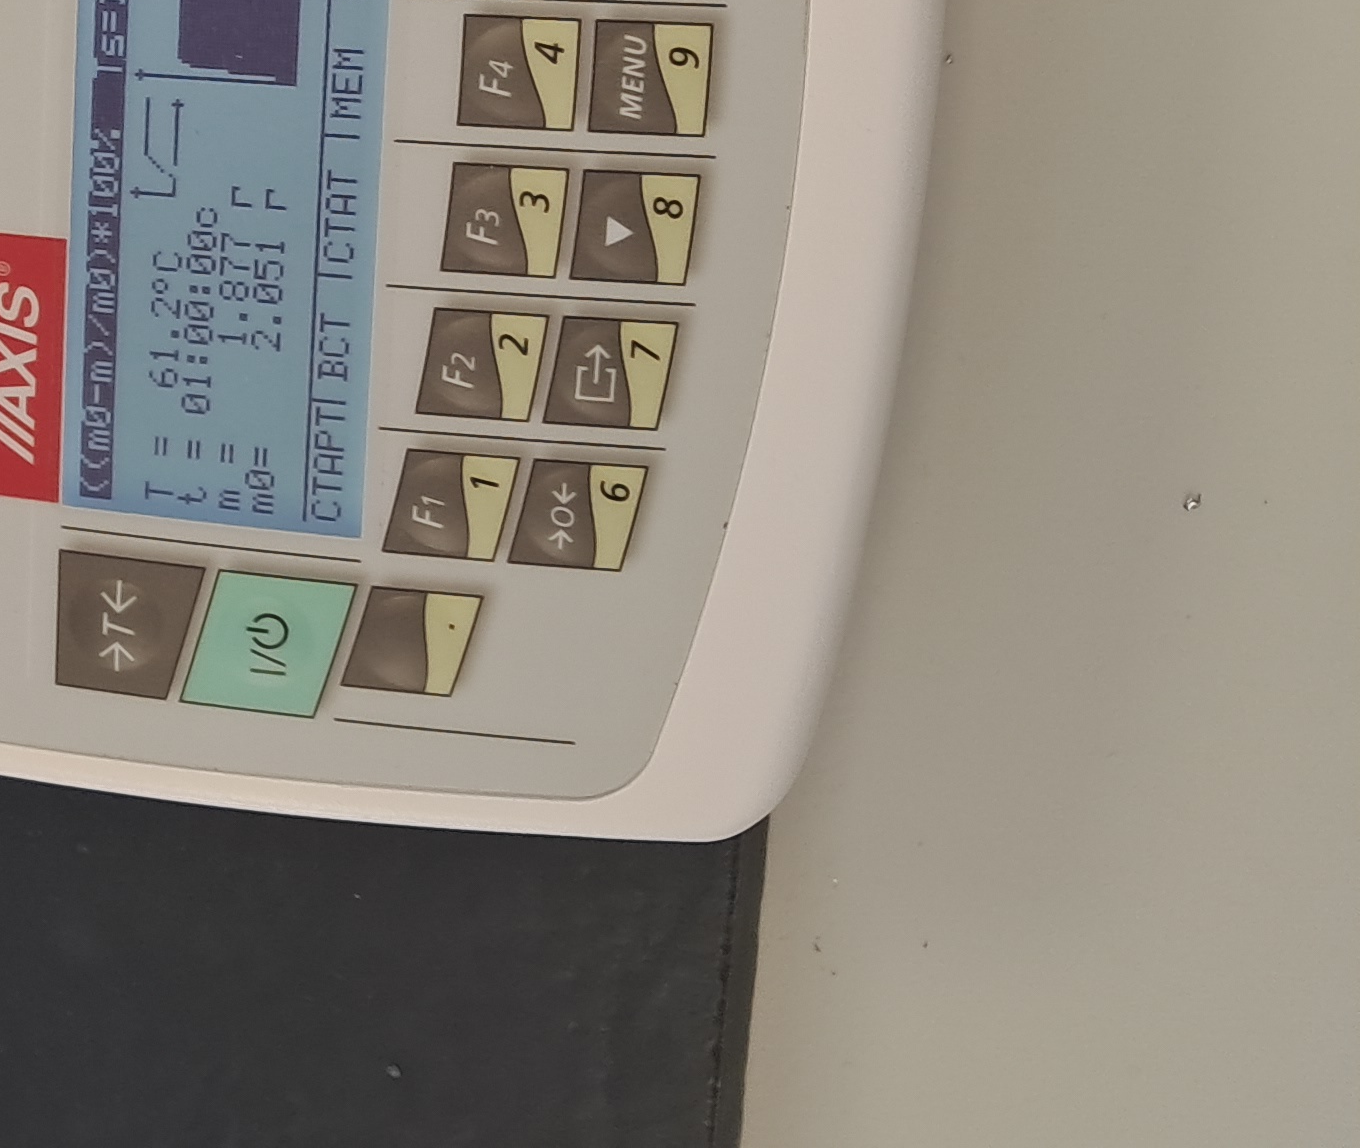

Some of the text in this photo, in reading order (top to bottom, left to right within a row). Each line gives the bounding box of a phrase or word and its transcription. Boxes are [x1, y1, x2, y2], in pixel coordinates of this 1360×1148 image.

[533, 40, 566, 66] 4
[667, 46, 701, 70] 9
[478, 59, 514, 98] F4
[618, 33, 648, 120] MENU
[322, 168, 359, 264] СТАТ
[518, 190, 551, 214] 3
[652, 196, 684, 220] 8
[465, 208, 501, 246] F3
[216, 232, 252, 346] 1.877
[250, 240, 286, 353] 2.051
[498, 332, 530, 357] 2
[630, 339, 662, 362] 7
[441, 352, 477, 389] F2
[309, 405, 347, 523] СТАРТ
[469, 476, 500, 490] 1
[599, 479, 631, 503] 6
[411, 495, 446, 530] F1
